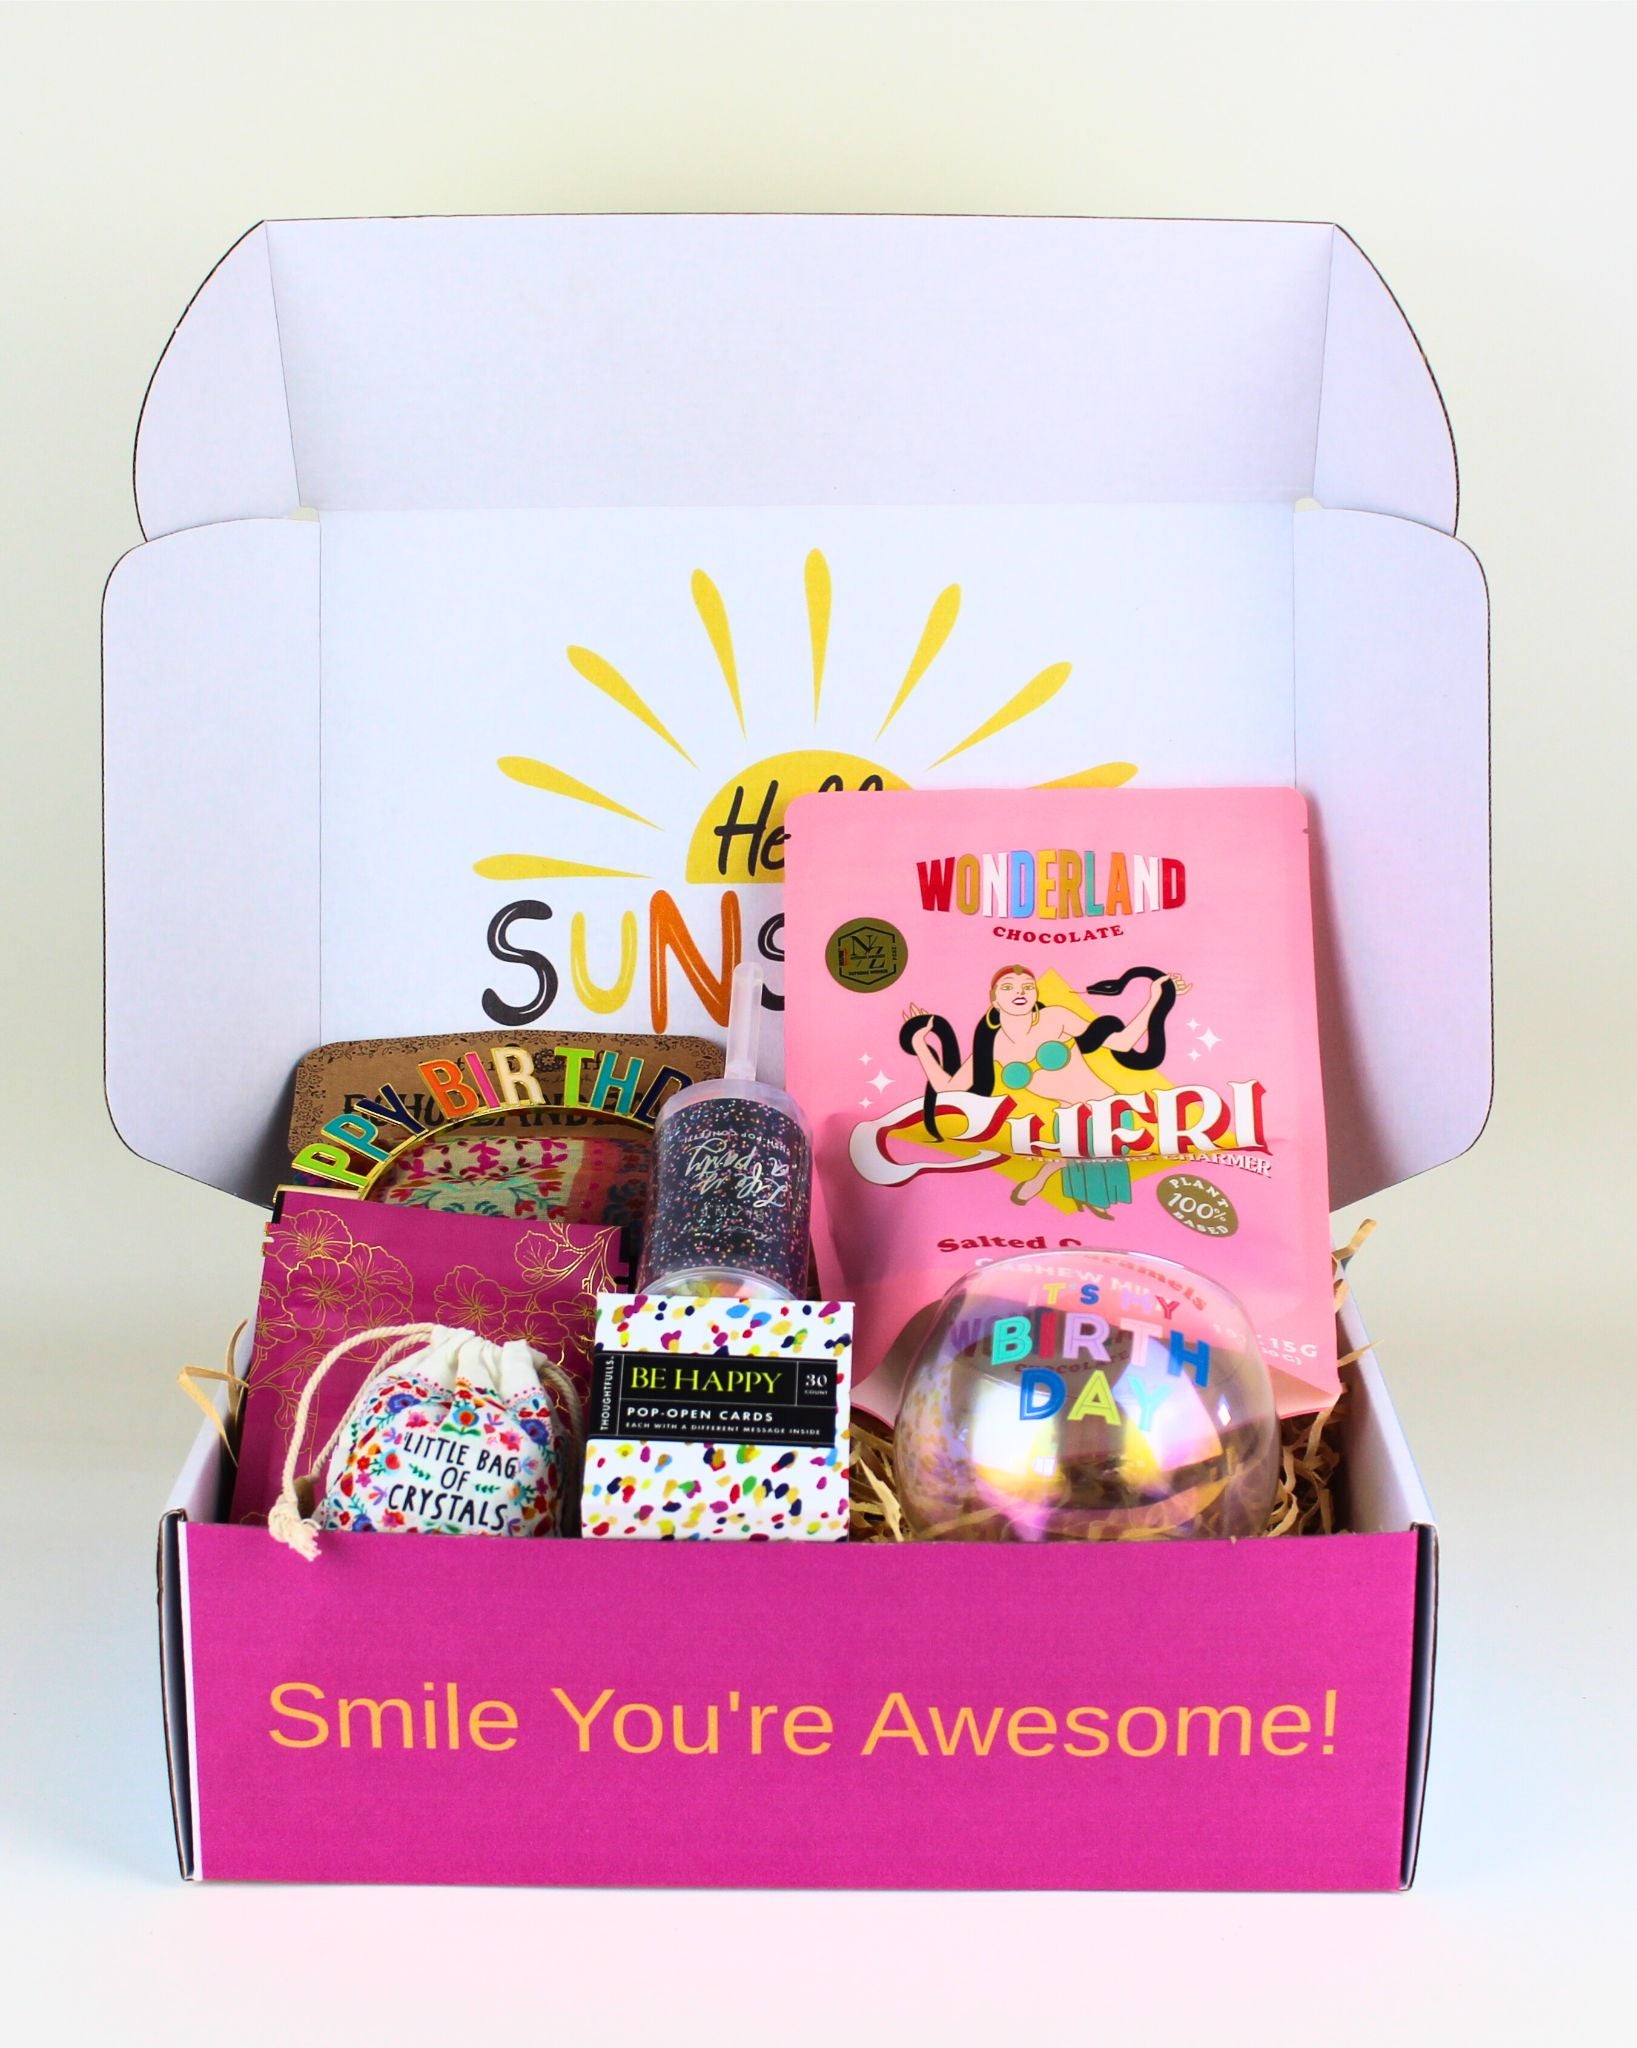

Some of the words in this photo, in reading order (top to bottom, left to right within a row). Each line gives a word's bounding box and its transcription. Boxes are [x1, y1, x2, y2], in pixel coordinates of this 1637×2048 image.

[916, 848, 1187, 920] WONDERLAND
[992, 925, 1125, 944] CHOCOLATE
[274, 1083, 427, 1201] PPY
[1169, 1177, 1229, 1208] PLANT
[1168, 1193, 1227, 1222] 100%
[1173, 1211, 1229, 1234] BASED
[937, 1235, 1047, 1252] Salted
[991, 1312, 1210, 1388] BIRTH
[630, 1366, 667, 1389] BE
[674, 1369, 783, 1394] HAPPY
[805, 1374, 828, 1387] 30
[626, 1406, 711, 1421] POP-OPEN
[719, 1410, 774, 1423] CARDS
[1019, 1368, 1174, 1432] DAY
[625, 1422, 650, 1430] EACH
[654, 1423, 678, 1431] WITH
[691, 1425, 740, 1433] DIFFERENT
[743, 1427, 786, 1435] MESSAGE
[404, 1431, 469, 1466] LITTLE
[476, 1449, 518, 1480] BAG
[440, 1466, 470, 1492] OF
[388, 1484, 508, 1532] CRYSTALS
[267, 1681, 520, 1752] Smile
[551, 1687, 833, 1757] You're
[861, 1688, 1340, 1758] Awesome!
